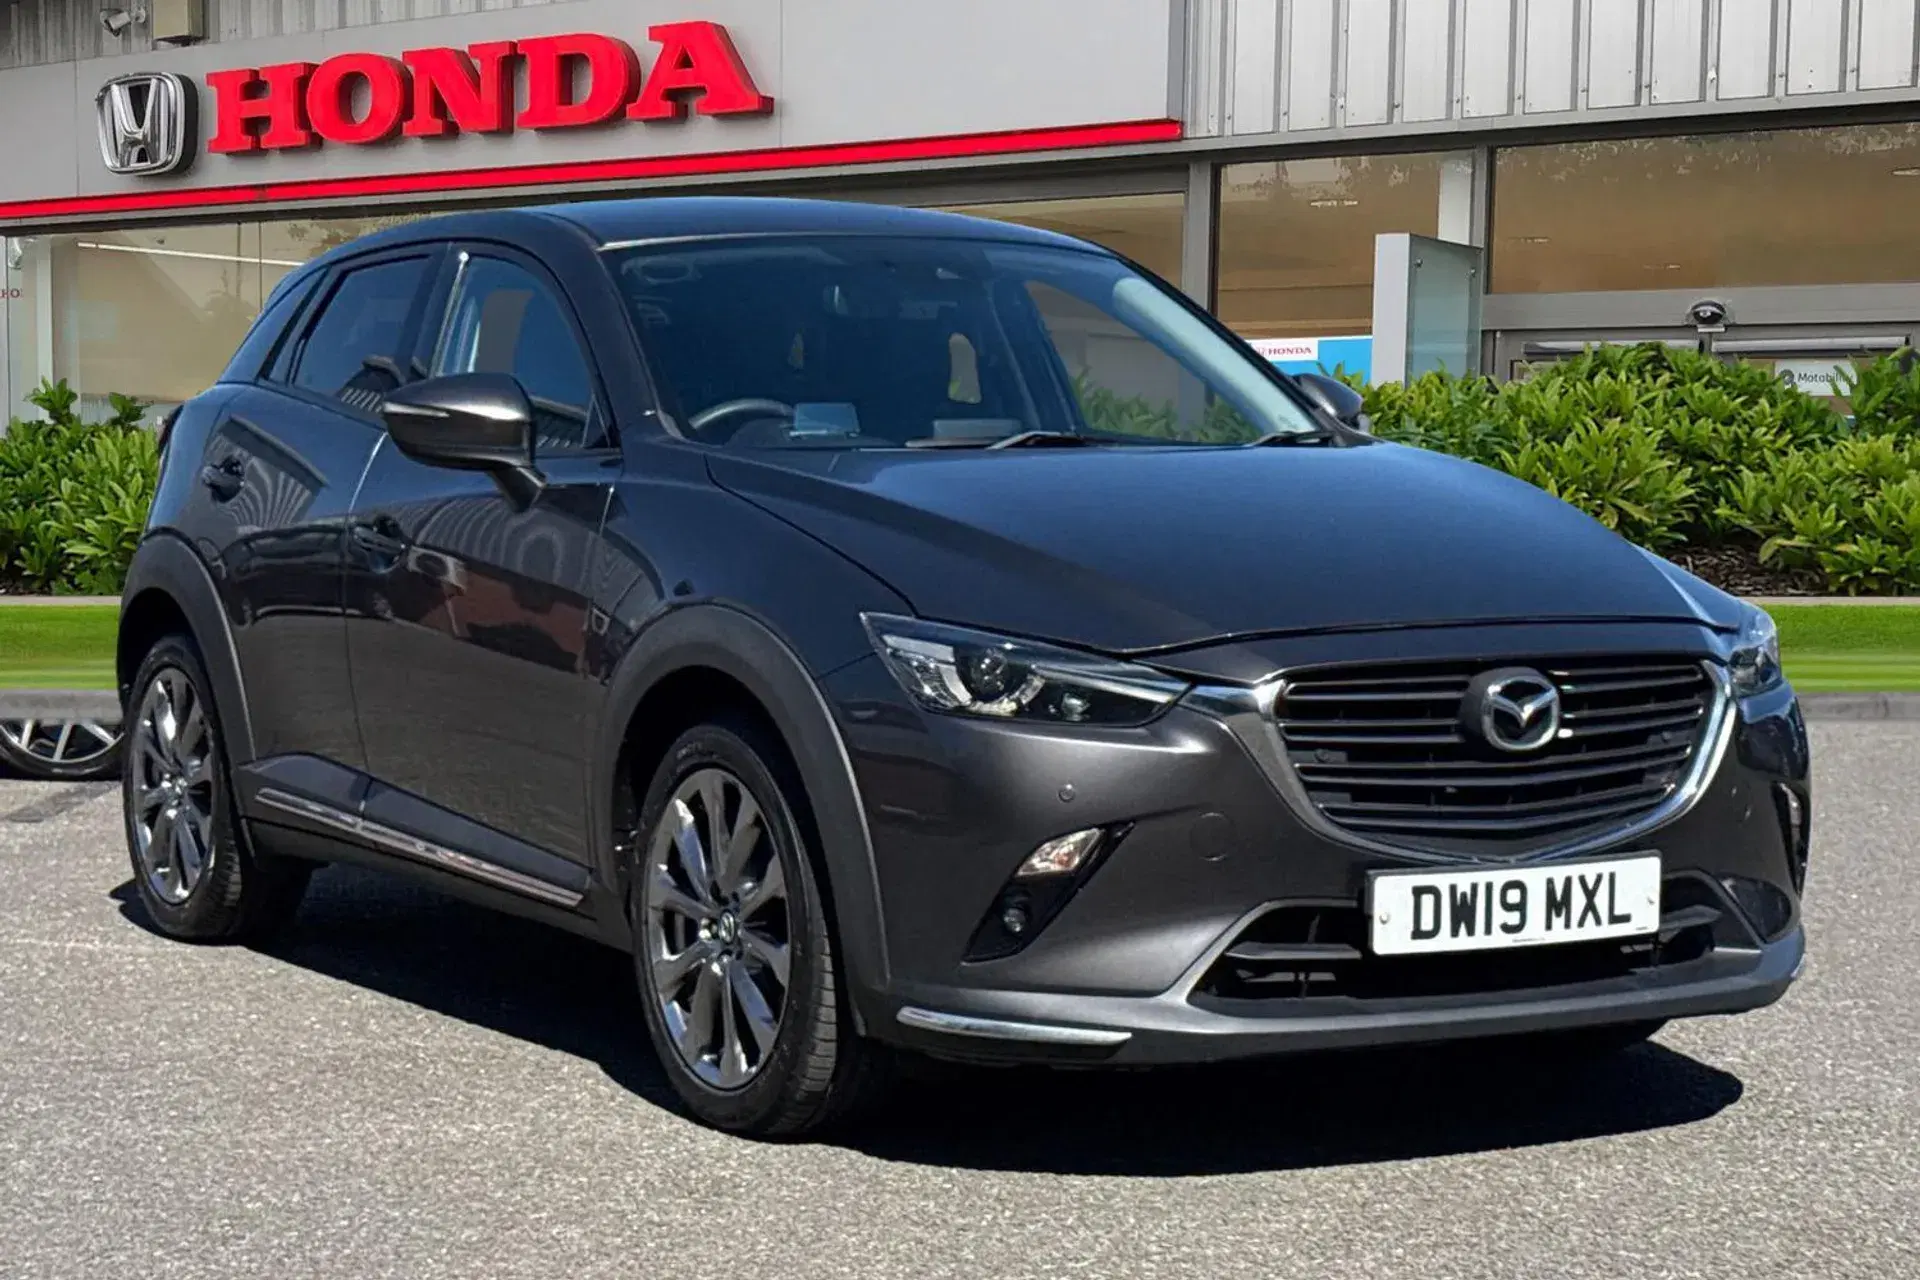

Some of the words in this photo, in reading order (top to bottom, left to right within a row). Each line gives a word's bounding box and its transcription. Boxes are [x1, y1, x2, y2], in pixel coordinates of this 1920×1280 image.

[207, 21, 773, 153] HONDA
[1268, 347, 1312, 355] HONDA
[1411, 879, 1528, 940] DW19
[1545, 871, 1632, 932] MXL
